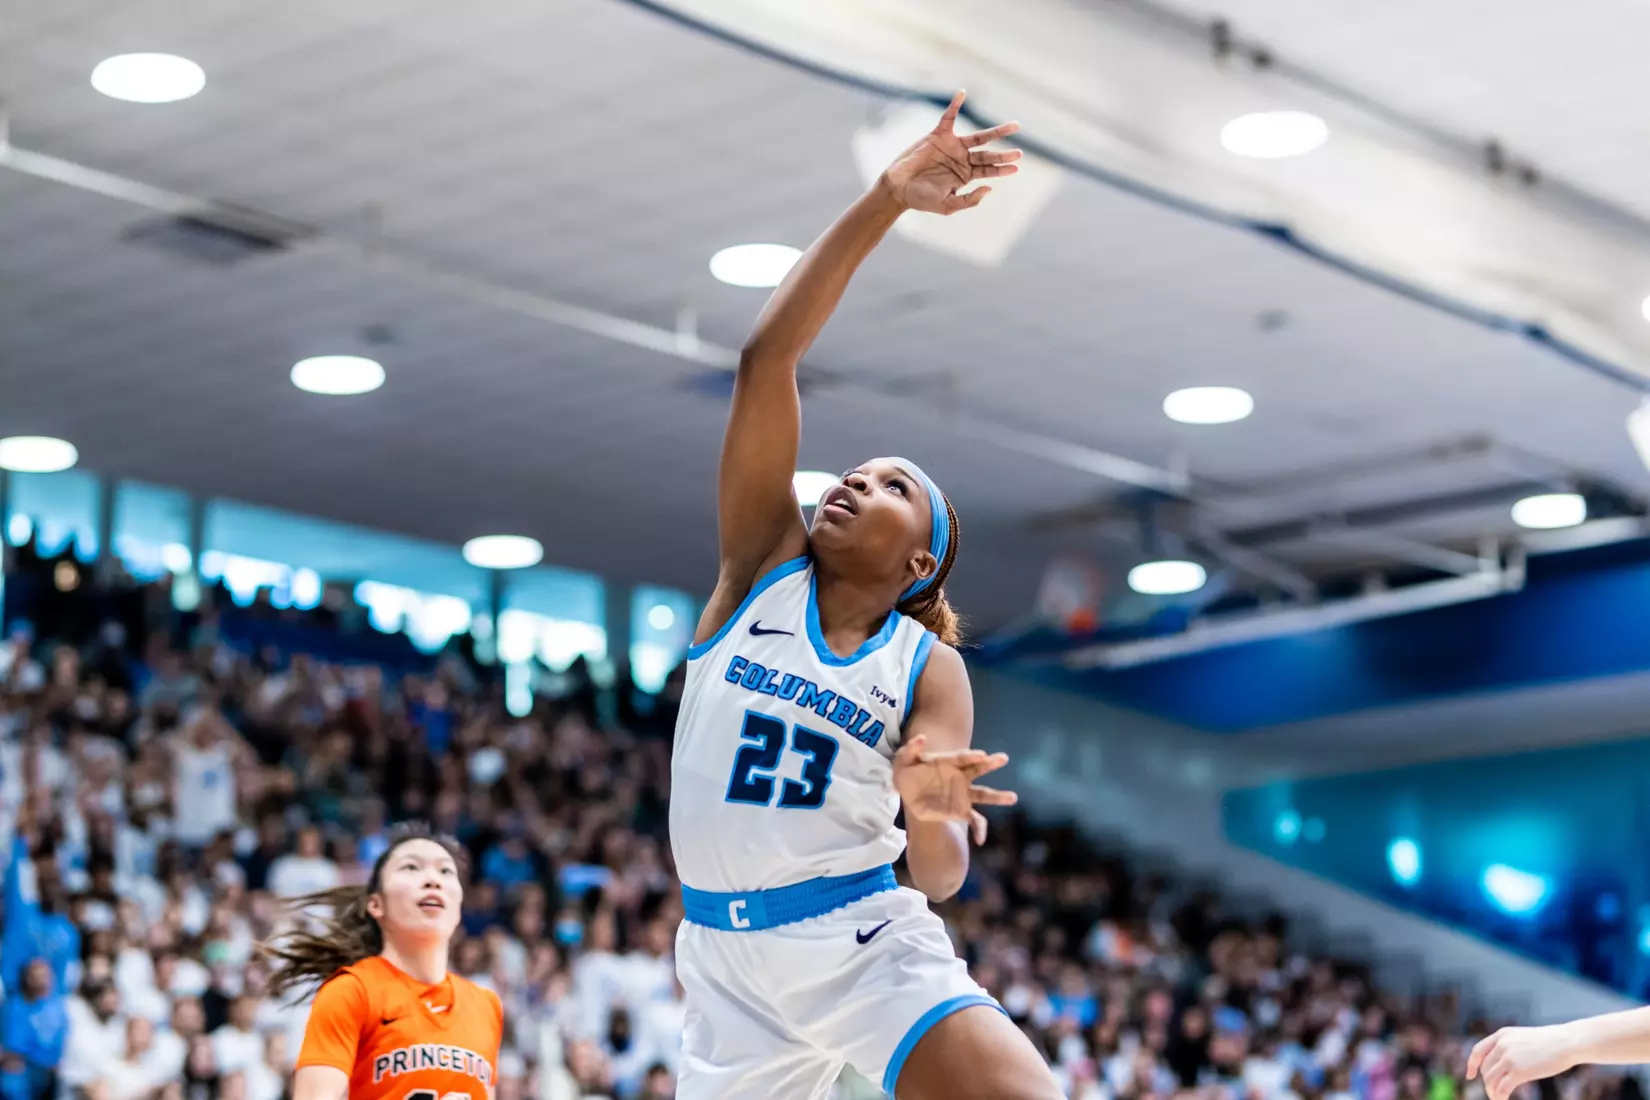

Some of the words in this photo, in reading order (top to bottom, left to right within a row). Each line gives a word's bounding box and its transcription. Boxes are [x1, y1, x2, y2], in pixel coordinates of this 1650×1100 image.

[725, 655, 885, 748] COLUMBIA
[870, 685, 890, 704] Ivy
[725, 709, 839, 810] 23
[728, 899, 750, 929] C
[373, 1044, 492, 1085] PRINCETO
